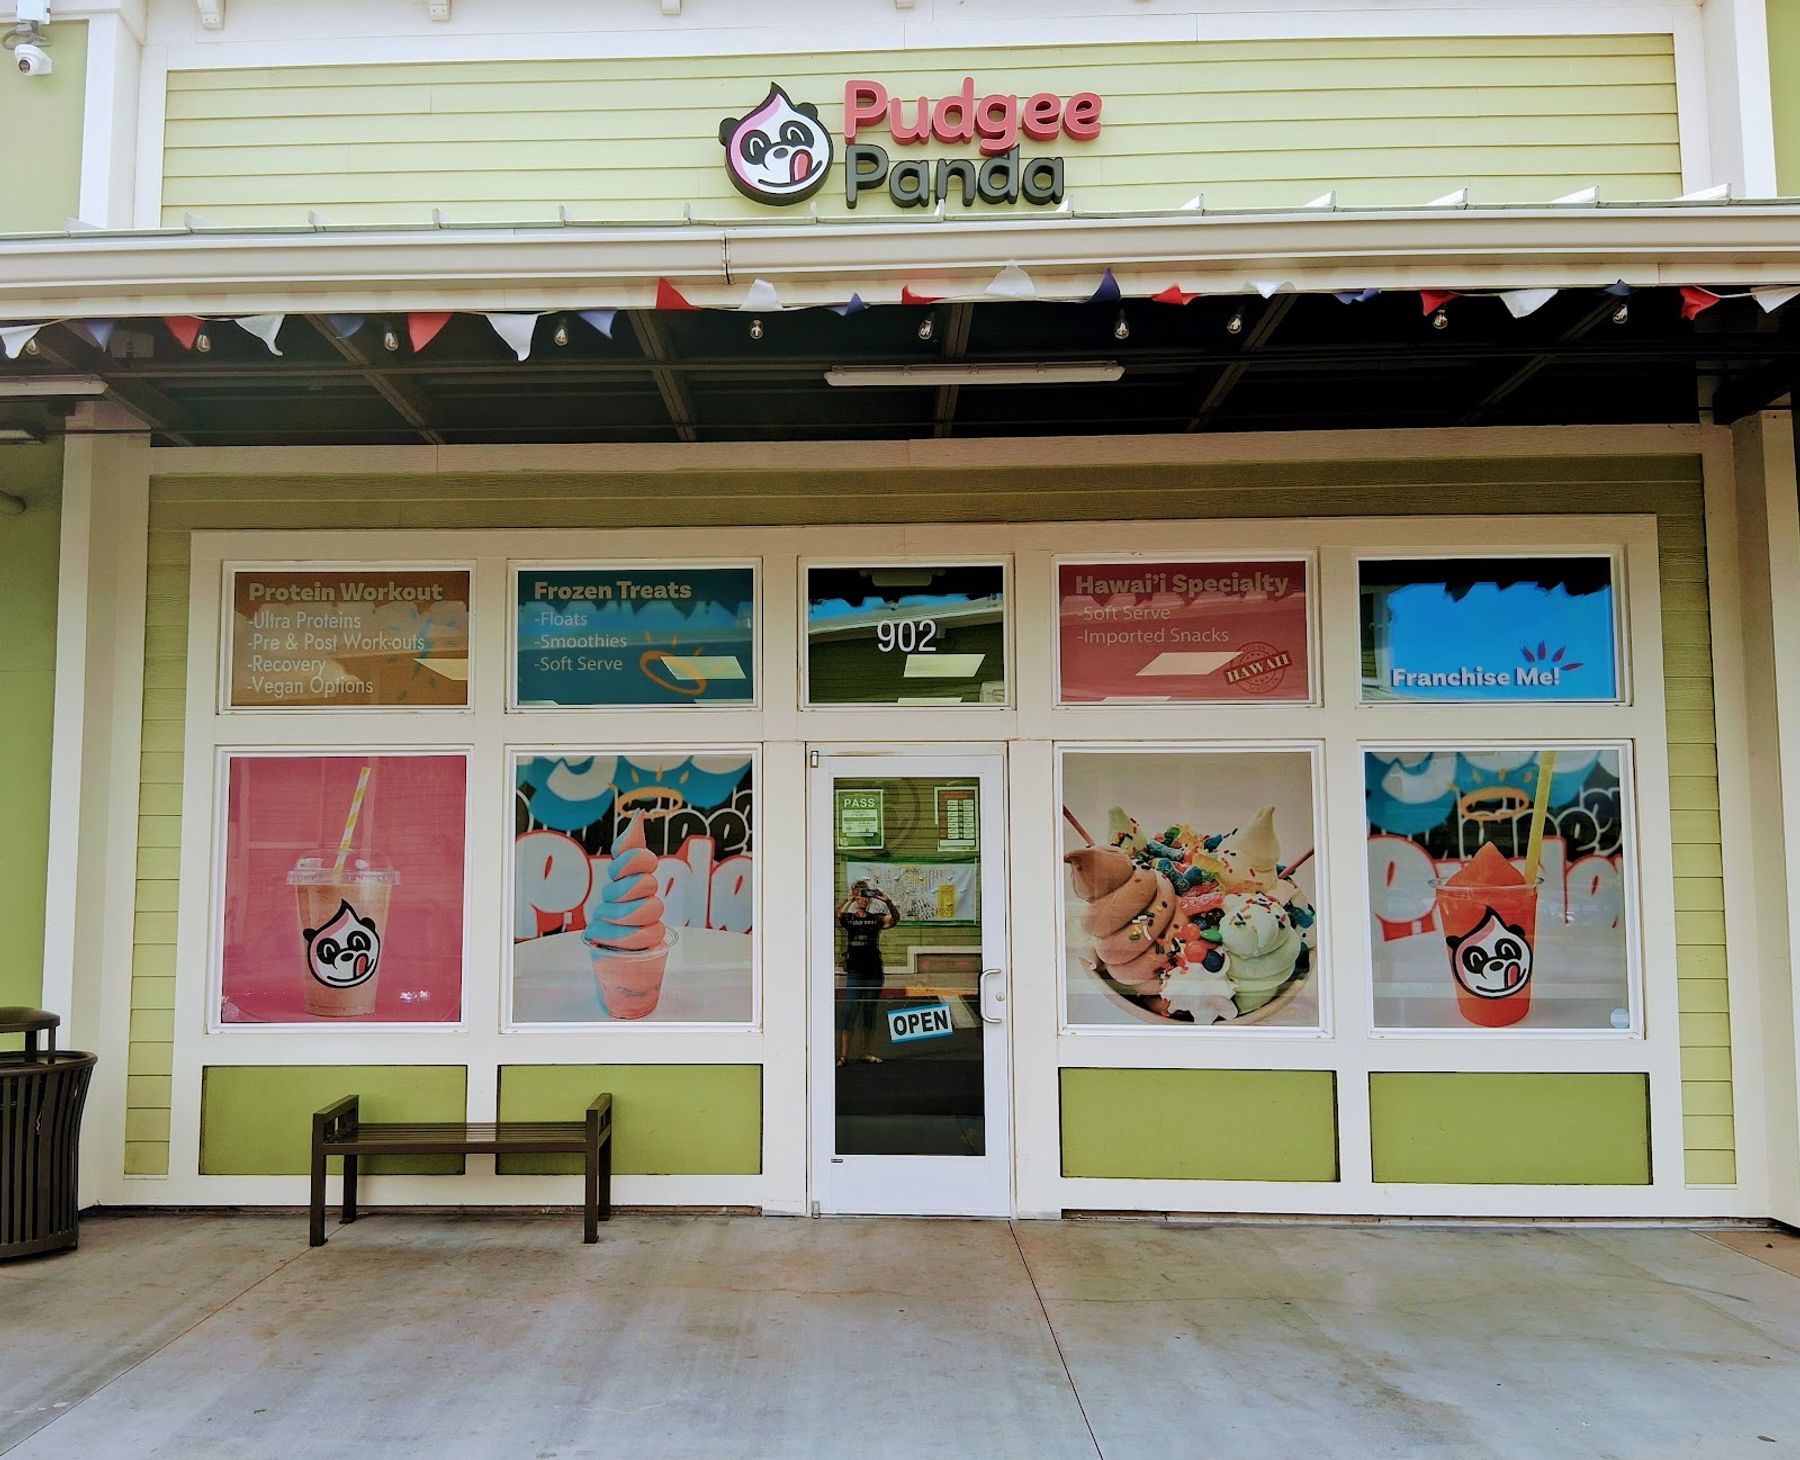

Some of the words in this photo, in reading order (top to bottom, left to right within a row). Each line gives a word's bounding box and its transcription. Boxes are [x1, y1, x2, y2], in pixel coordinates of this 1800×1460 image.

[843, 77, 1103, 156] Pudgee
[845, 143, 1065, 209] Panda
[249, 581, 336, 601] Protein
[339, 581, 444, 601] Workout
[534, 582, 612, 600] Frozen
[616, 580, 692, 599] Treats
[1172, 571, 1290, 597] Specialty
[296, 610, 362, 629] Proteins
[1123, 606, 1171, 621] Serve
[286, 634, 299, 651] &
[304, 635, 338, 651] Post
[343, 631, 426, 651] Work-outs
[876, 619, 937, 653] 902
[1170, 627, 1230, 643] Snacks
[576, 658, 624, 672] Serve
[1226, 654, 1291, 683] HAWAII
[310, 677, 374, 697] Options
[1391, 666, 1510, 688] Franchise
[1514, 667, 1561, 687] Me!
[843, 798, 876, 808] PASS
[893, 1010, 949, 1036] OPEN
